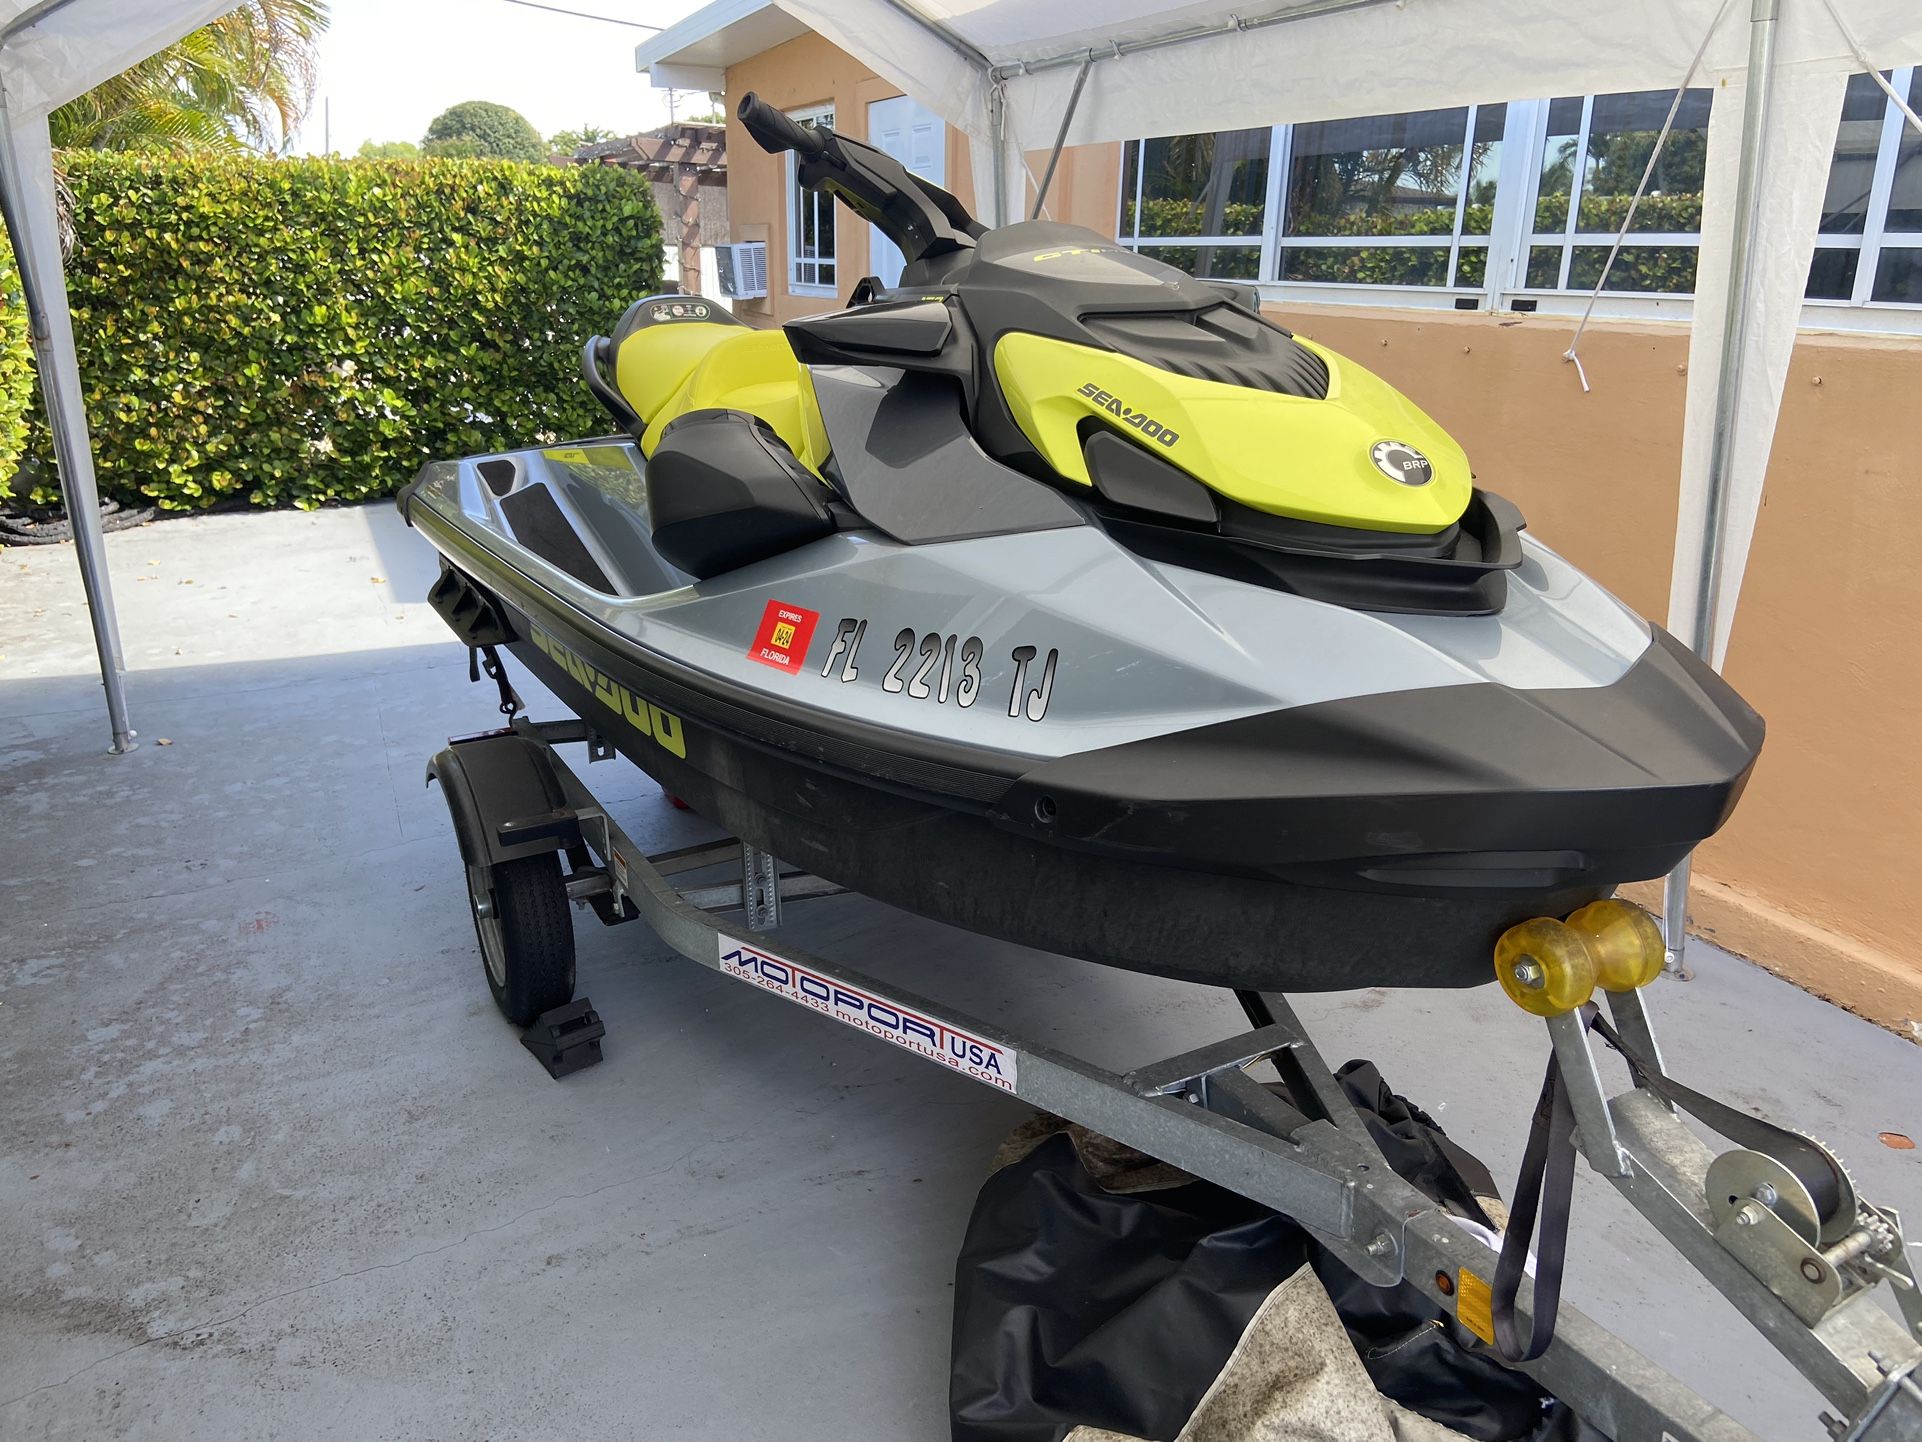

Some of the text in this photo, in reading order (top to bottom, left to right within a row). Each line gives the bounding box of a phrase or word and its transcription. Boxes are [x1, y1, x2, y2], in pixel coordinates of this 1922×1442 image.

[1402, 459, 1429, 471] BRP
[778, 609, 803, 623] EXPIRES
[760, 647, 791, 666] FLORIDA
[820, 618, 1059, 722] FL 2213 TJ
[724, 962, 1013, 1091] 305-264-4433 motoportusa.com
[950, 1035, 1003, 1076] USA
